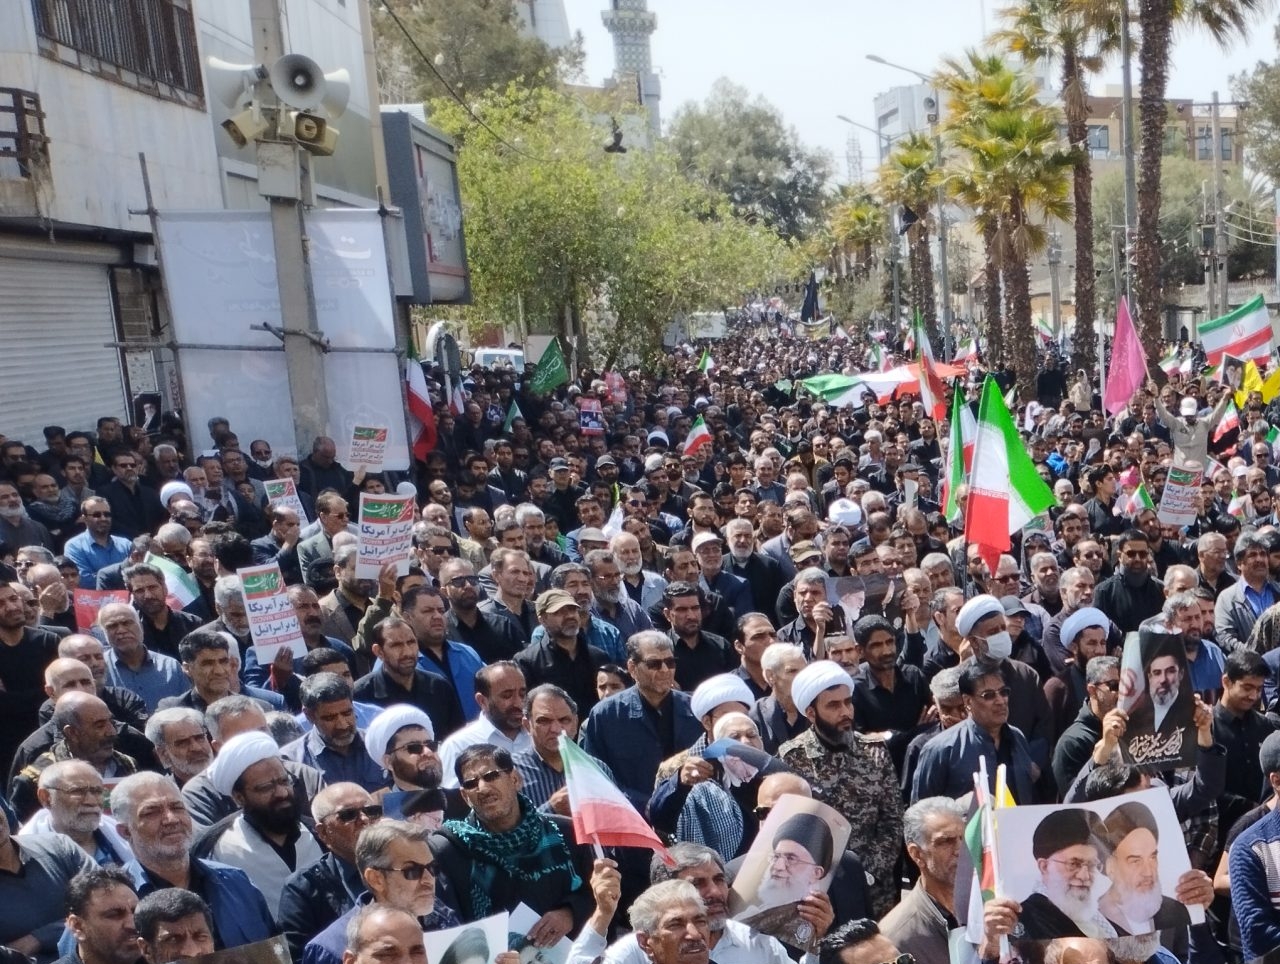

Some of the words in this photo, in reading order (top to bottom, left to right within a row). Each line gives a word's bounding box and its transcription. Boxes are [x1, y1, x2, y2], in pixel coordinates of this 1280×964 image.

[362, 524, 391, 538] آمریکا
[391, 528, 398, 537] بر
[398, 524, 412, 533] مرگ
[360, 546, 388, 557] اسرائیل
[396, 543, 409, 551] مرگ
[249, 598, 276, 613] آمریکا
[279, 601, 285, 611] بر
[255, 623, 283, 636] اسرائیل
[285, 623, 290, 632] بر
